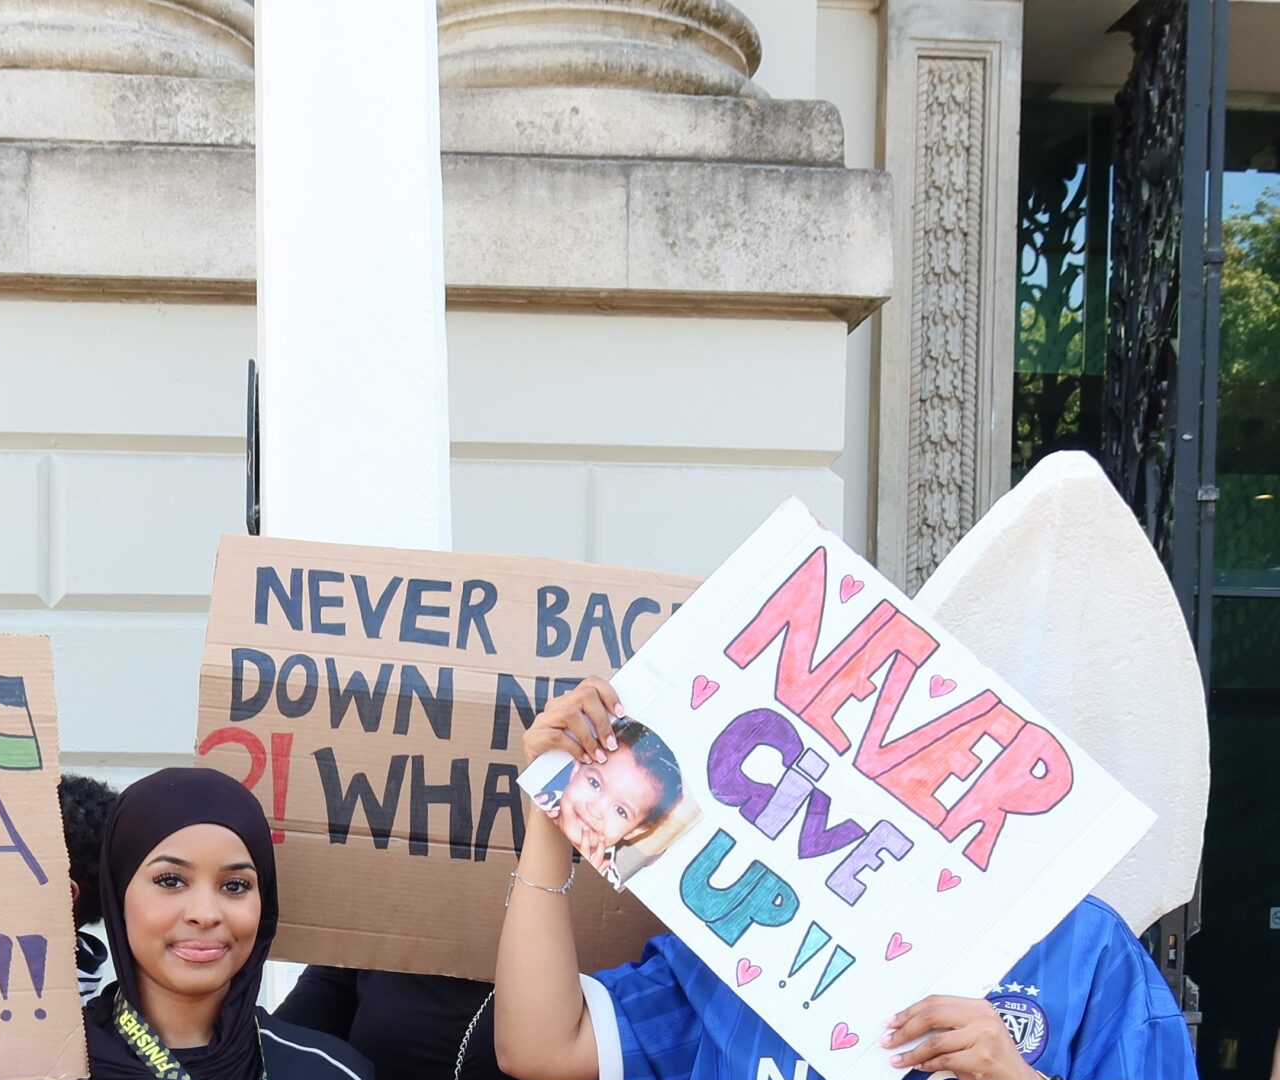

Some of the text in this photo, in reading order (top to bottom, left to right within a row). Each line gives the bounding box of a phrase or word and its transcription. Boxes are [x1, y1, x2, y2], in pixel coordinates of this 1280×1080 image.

[254, 566, 686, 669] NEVER BAC
[229, 647, 454, 740] DOWN
[723, 545, 1074, 872] NEVER
[118, 1009, 174, 1073] FINISHER
[1004, 1001, 1028, 1011] 2013
